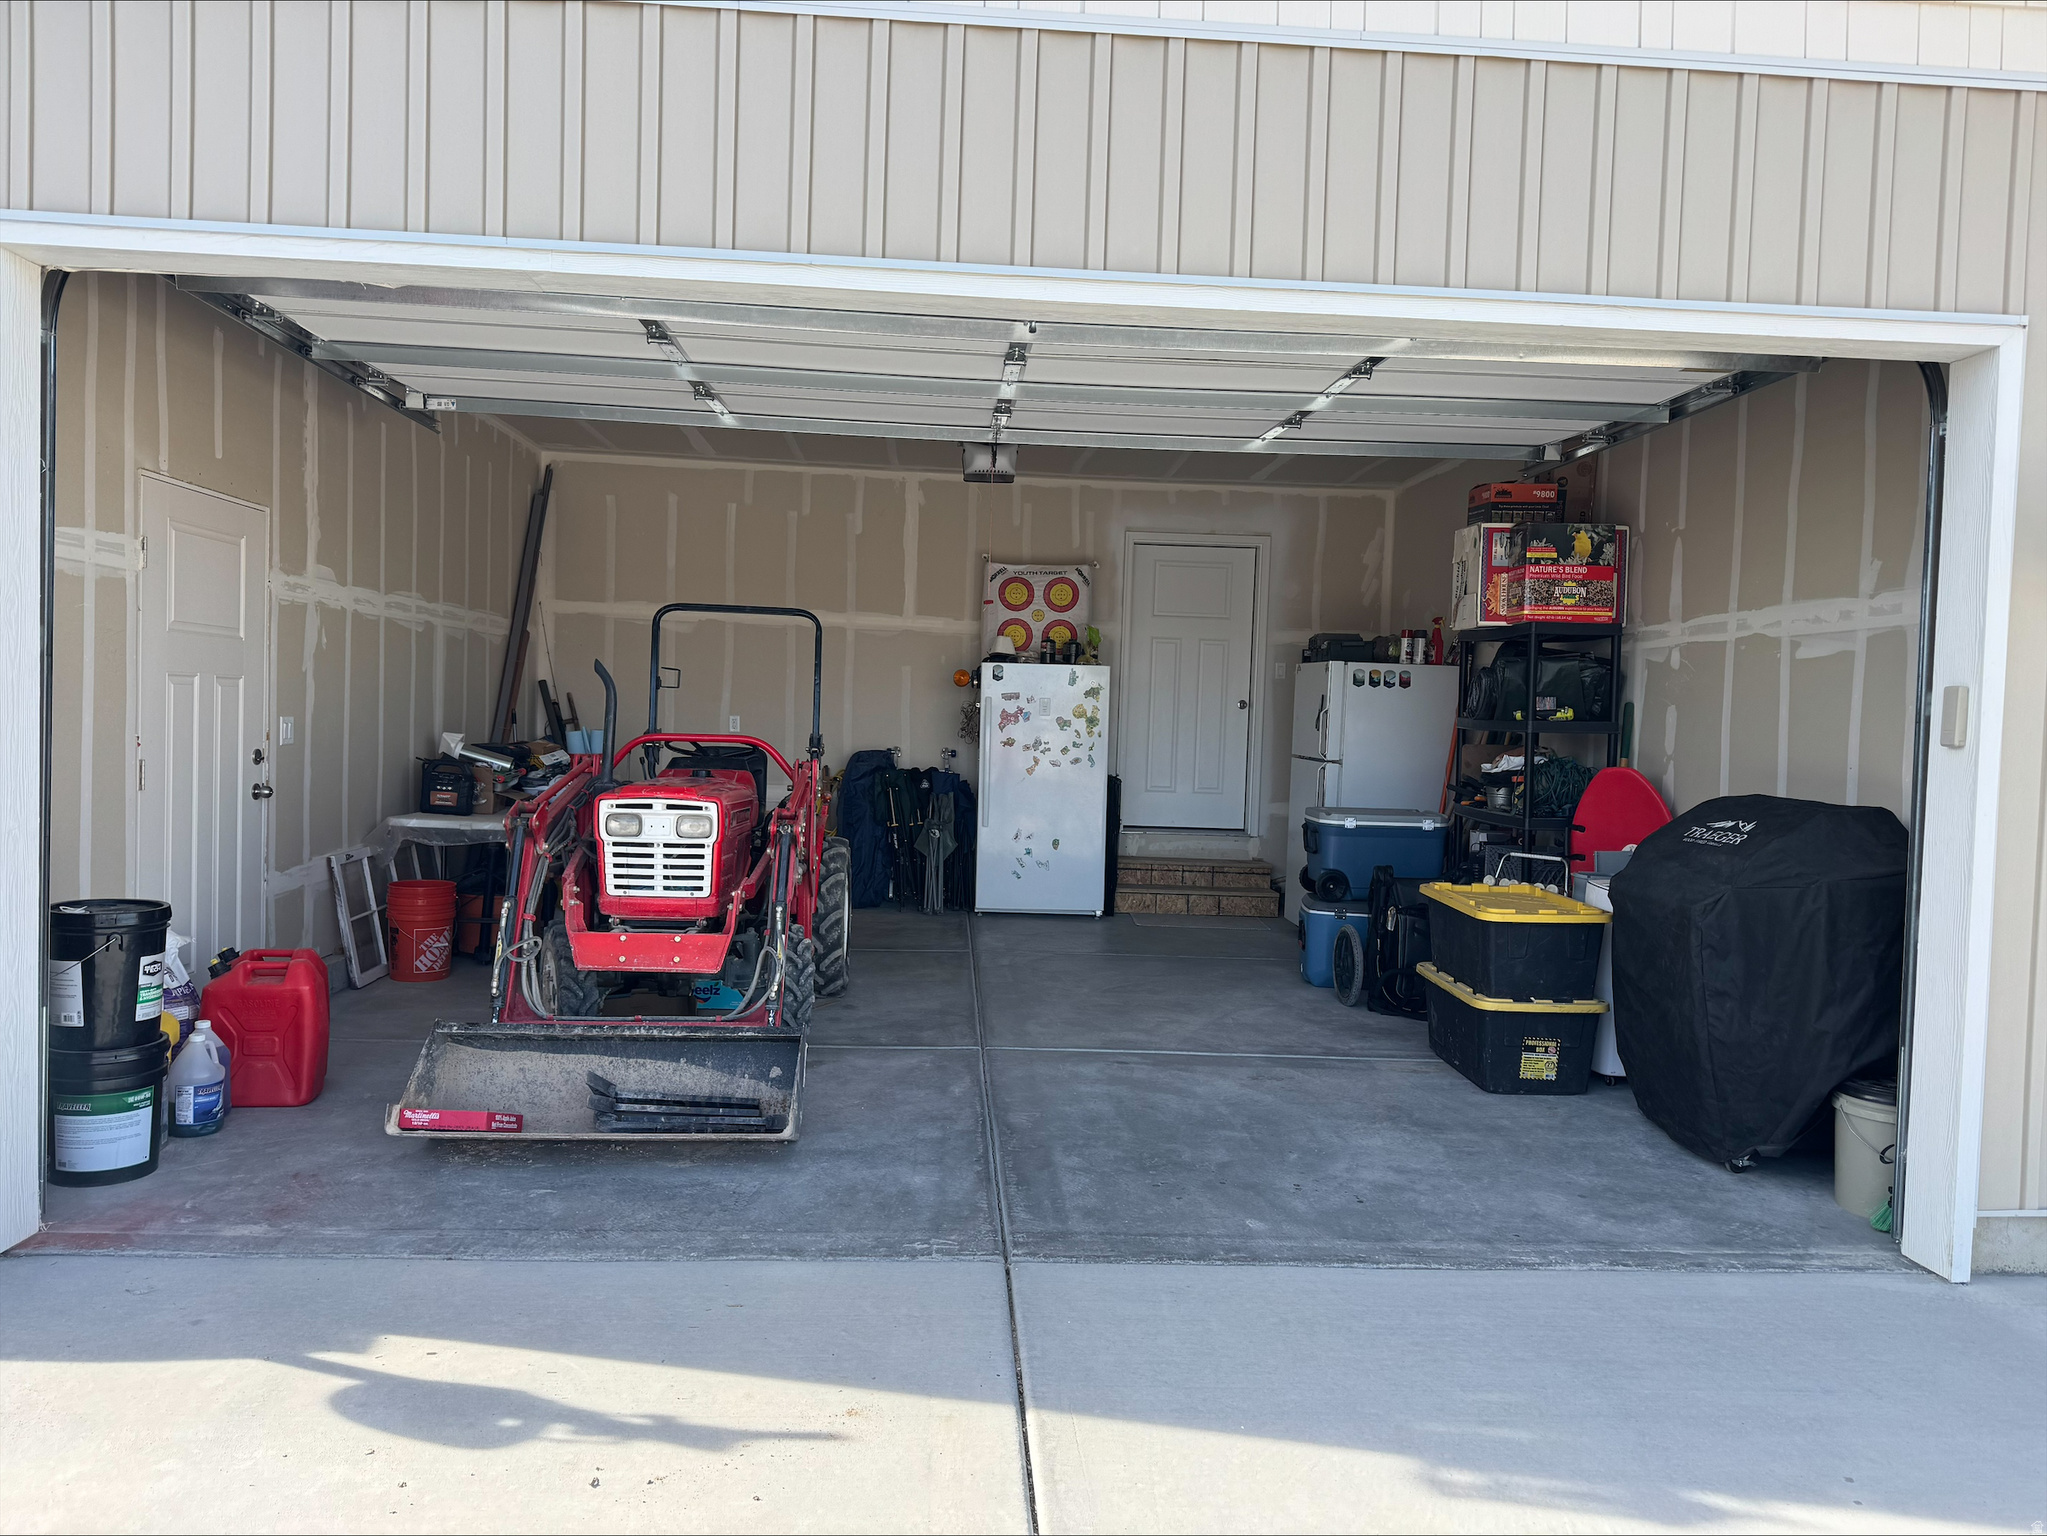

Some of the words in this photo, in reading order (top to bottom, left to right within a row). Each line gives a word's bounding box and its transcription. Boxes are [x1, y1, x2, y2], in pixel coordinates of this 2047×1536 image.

[1565, 566, 1588, 574] BLEND
[1553, 586, 1587, 597] AUDUBON
[1684, 826, 1748, 845] TRAEGER
[419, 933, 440, 951] THE
[415, 926, 452, 973] HOME
[145, 966, 161, 974] TECH
[57, 1102, 92, 1111] TRAVELLER
[403, 1109, 440, 1120] Martinelli's
